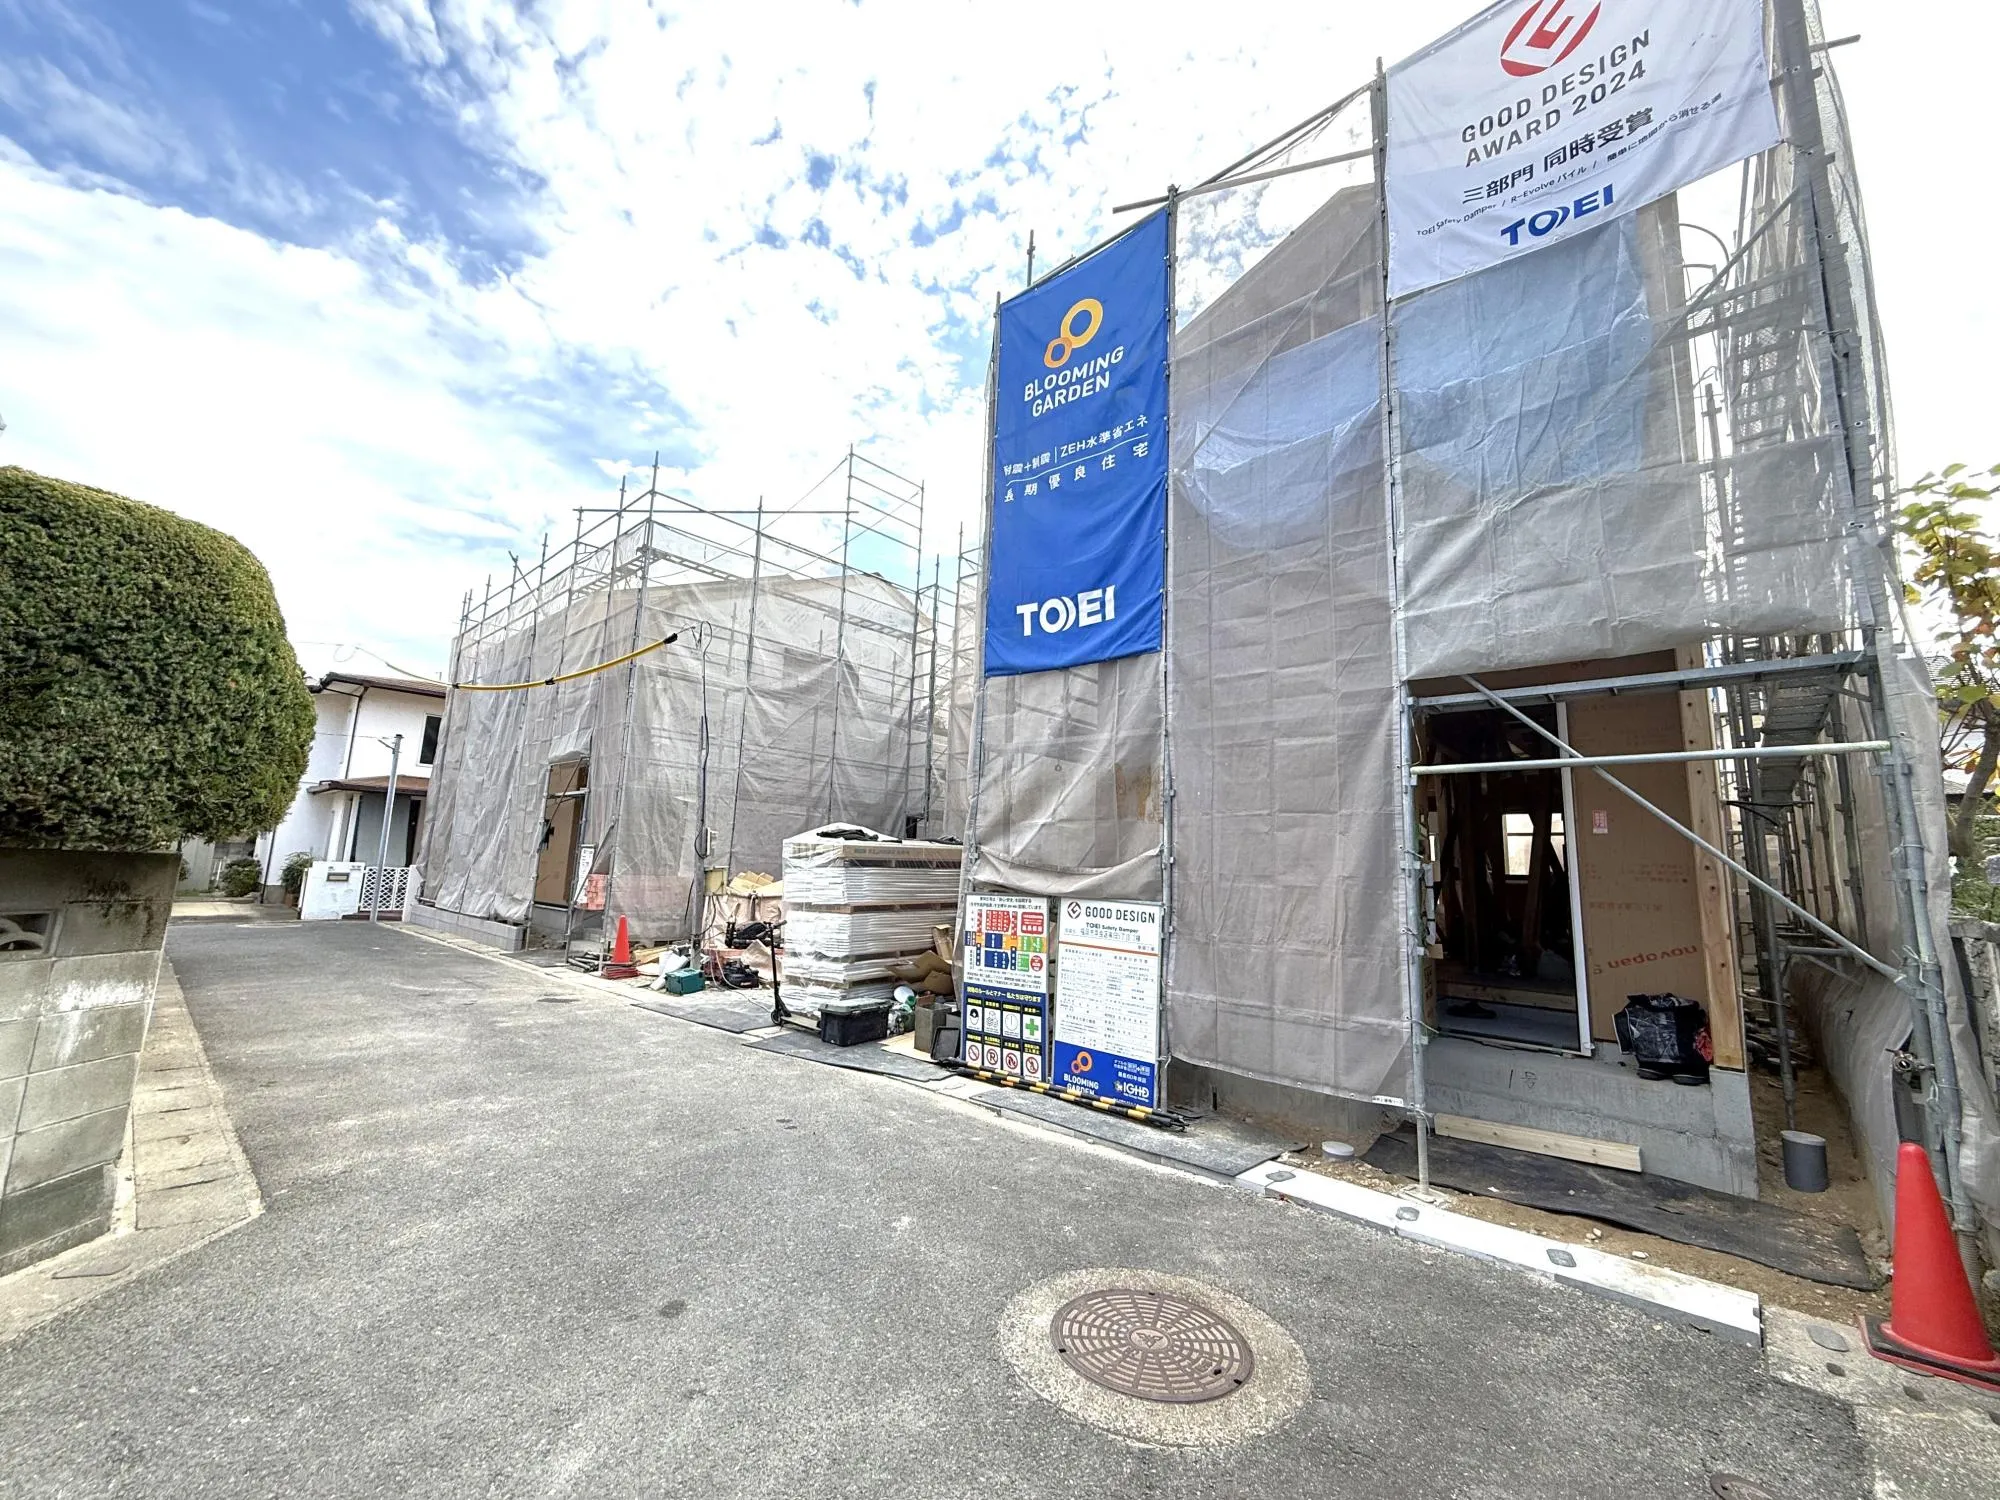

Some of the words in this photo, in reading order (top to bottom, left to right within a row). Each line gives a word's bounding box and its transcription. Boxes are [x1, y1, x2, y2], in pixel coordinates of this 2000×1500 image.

[1461, 98, 1532, 144] GOOD
[1541, 29, 1651, 107] DESIGN
[1465, 108, 1562, 167] AWARD
[1572, 59, 1646, 119] 2024
[1462, 163, 1534, 205] 三部門
[1543, 106, 1654, 173] 同時受賞
[1416, 225, 1436, 236] TOEI
[1436, 218, 1462, 230] Safety
[1463, 204, 1497, 222] Damper
[1510, 179, 1555, 203] R-Evolve
[1500, 183, 1614, 246] TOEI
[1024, 345, 1125, 403] BLOOMING
[1032, 380, 1110, 418] GARDEN
[1016, 584, 1116, 637] TOEI
[1085, 906, 1113, 920] GOOD
[1116, 909, 1155, 924] DESIGN
[1607, 945, 1698, 969] novopan
[1063, 1073, 1099, 1090] BLOOMING
